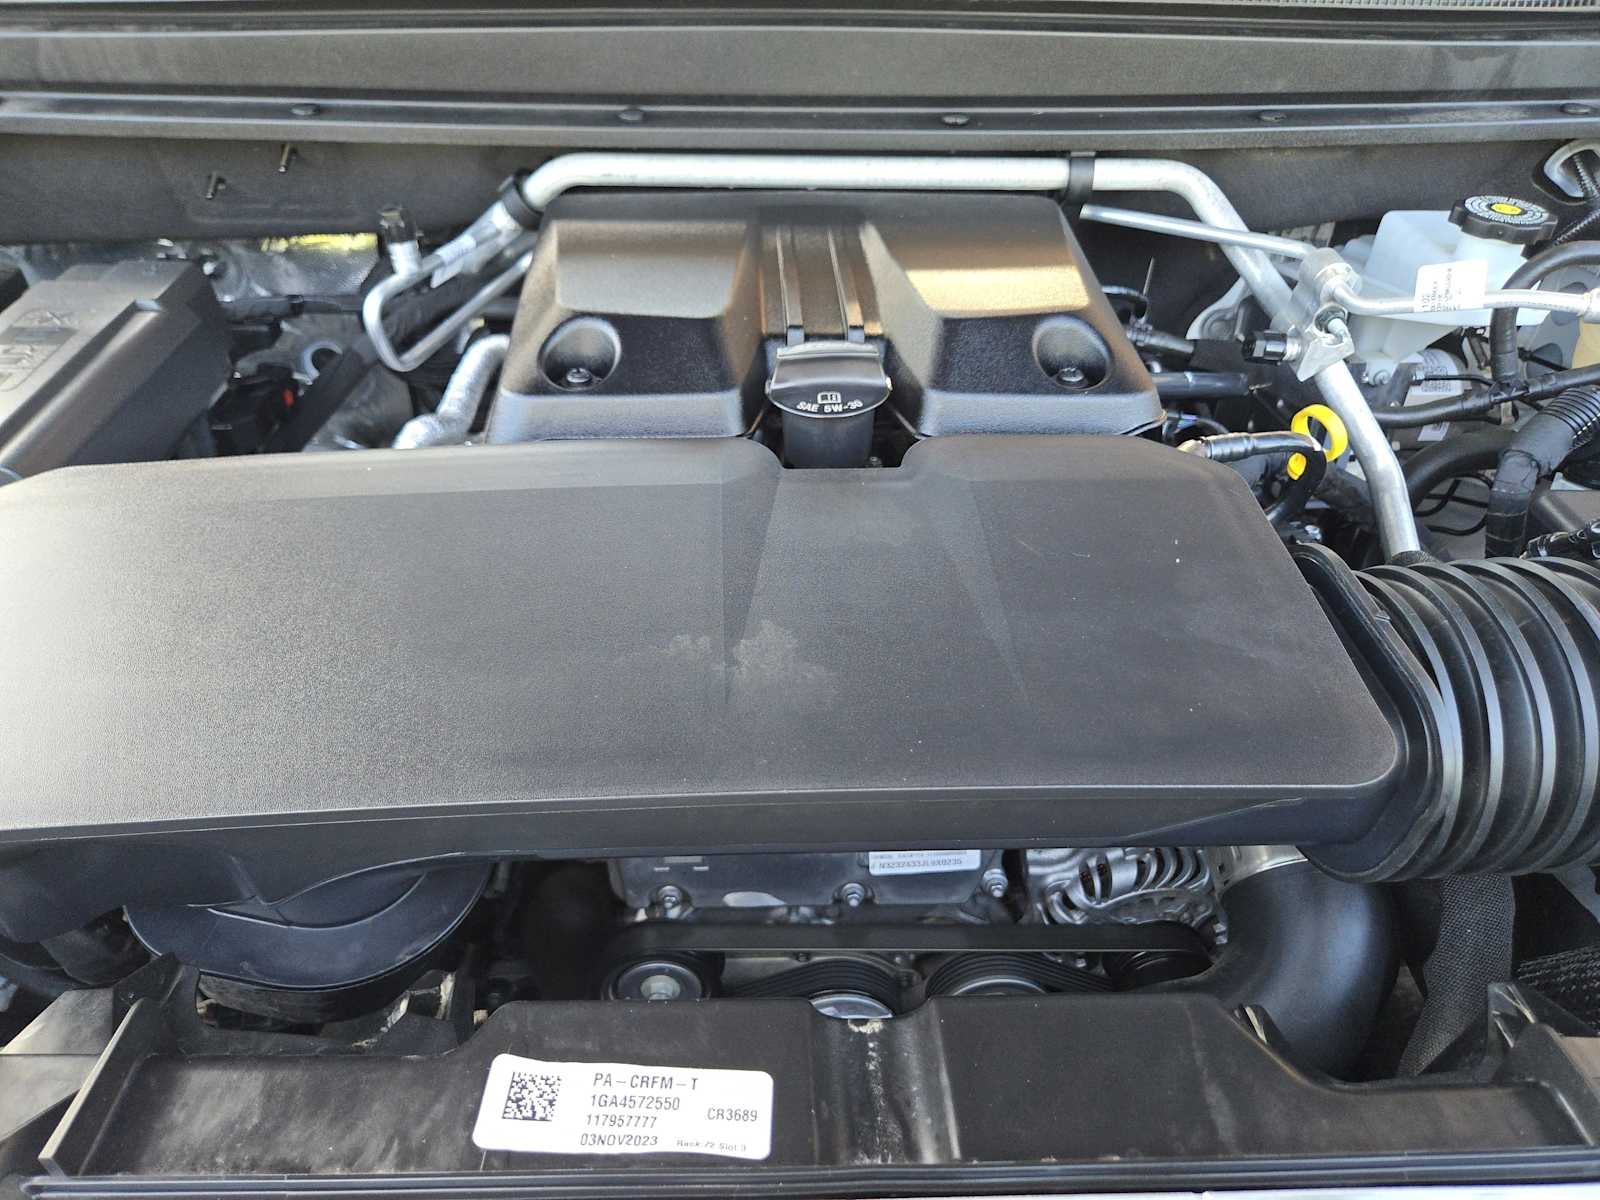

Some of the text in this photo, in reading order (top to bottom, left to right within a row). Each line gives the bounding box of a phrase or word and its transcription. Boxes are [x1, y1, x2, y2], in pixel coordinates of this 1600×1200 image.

[796, 399, 864, 413] SAE 5W-30
[590, 1094, 681, 1112] 1GA4572550
[586, 1114, 657, 1129] 117957777
[707, 1107, 758, 1123] CR3689
[580, 1133, 659, 1147] 03NOV2023
